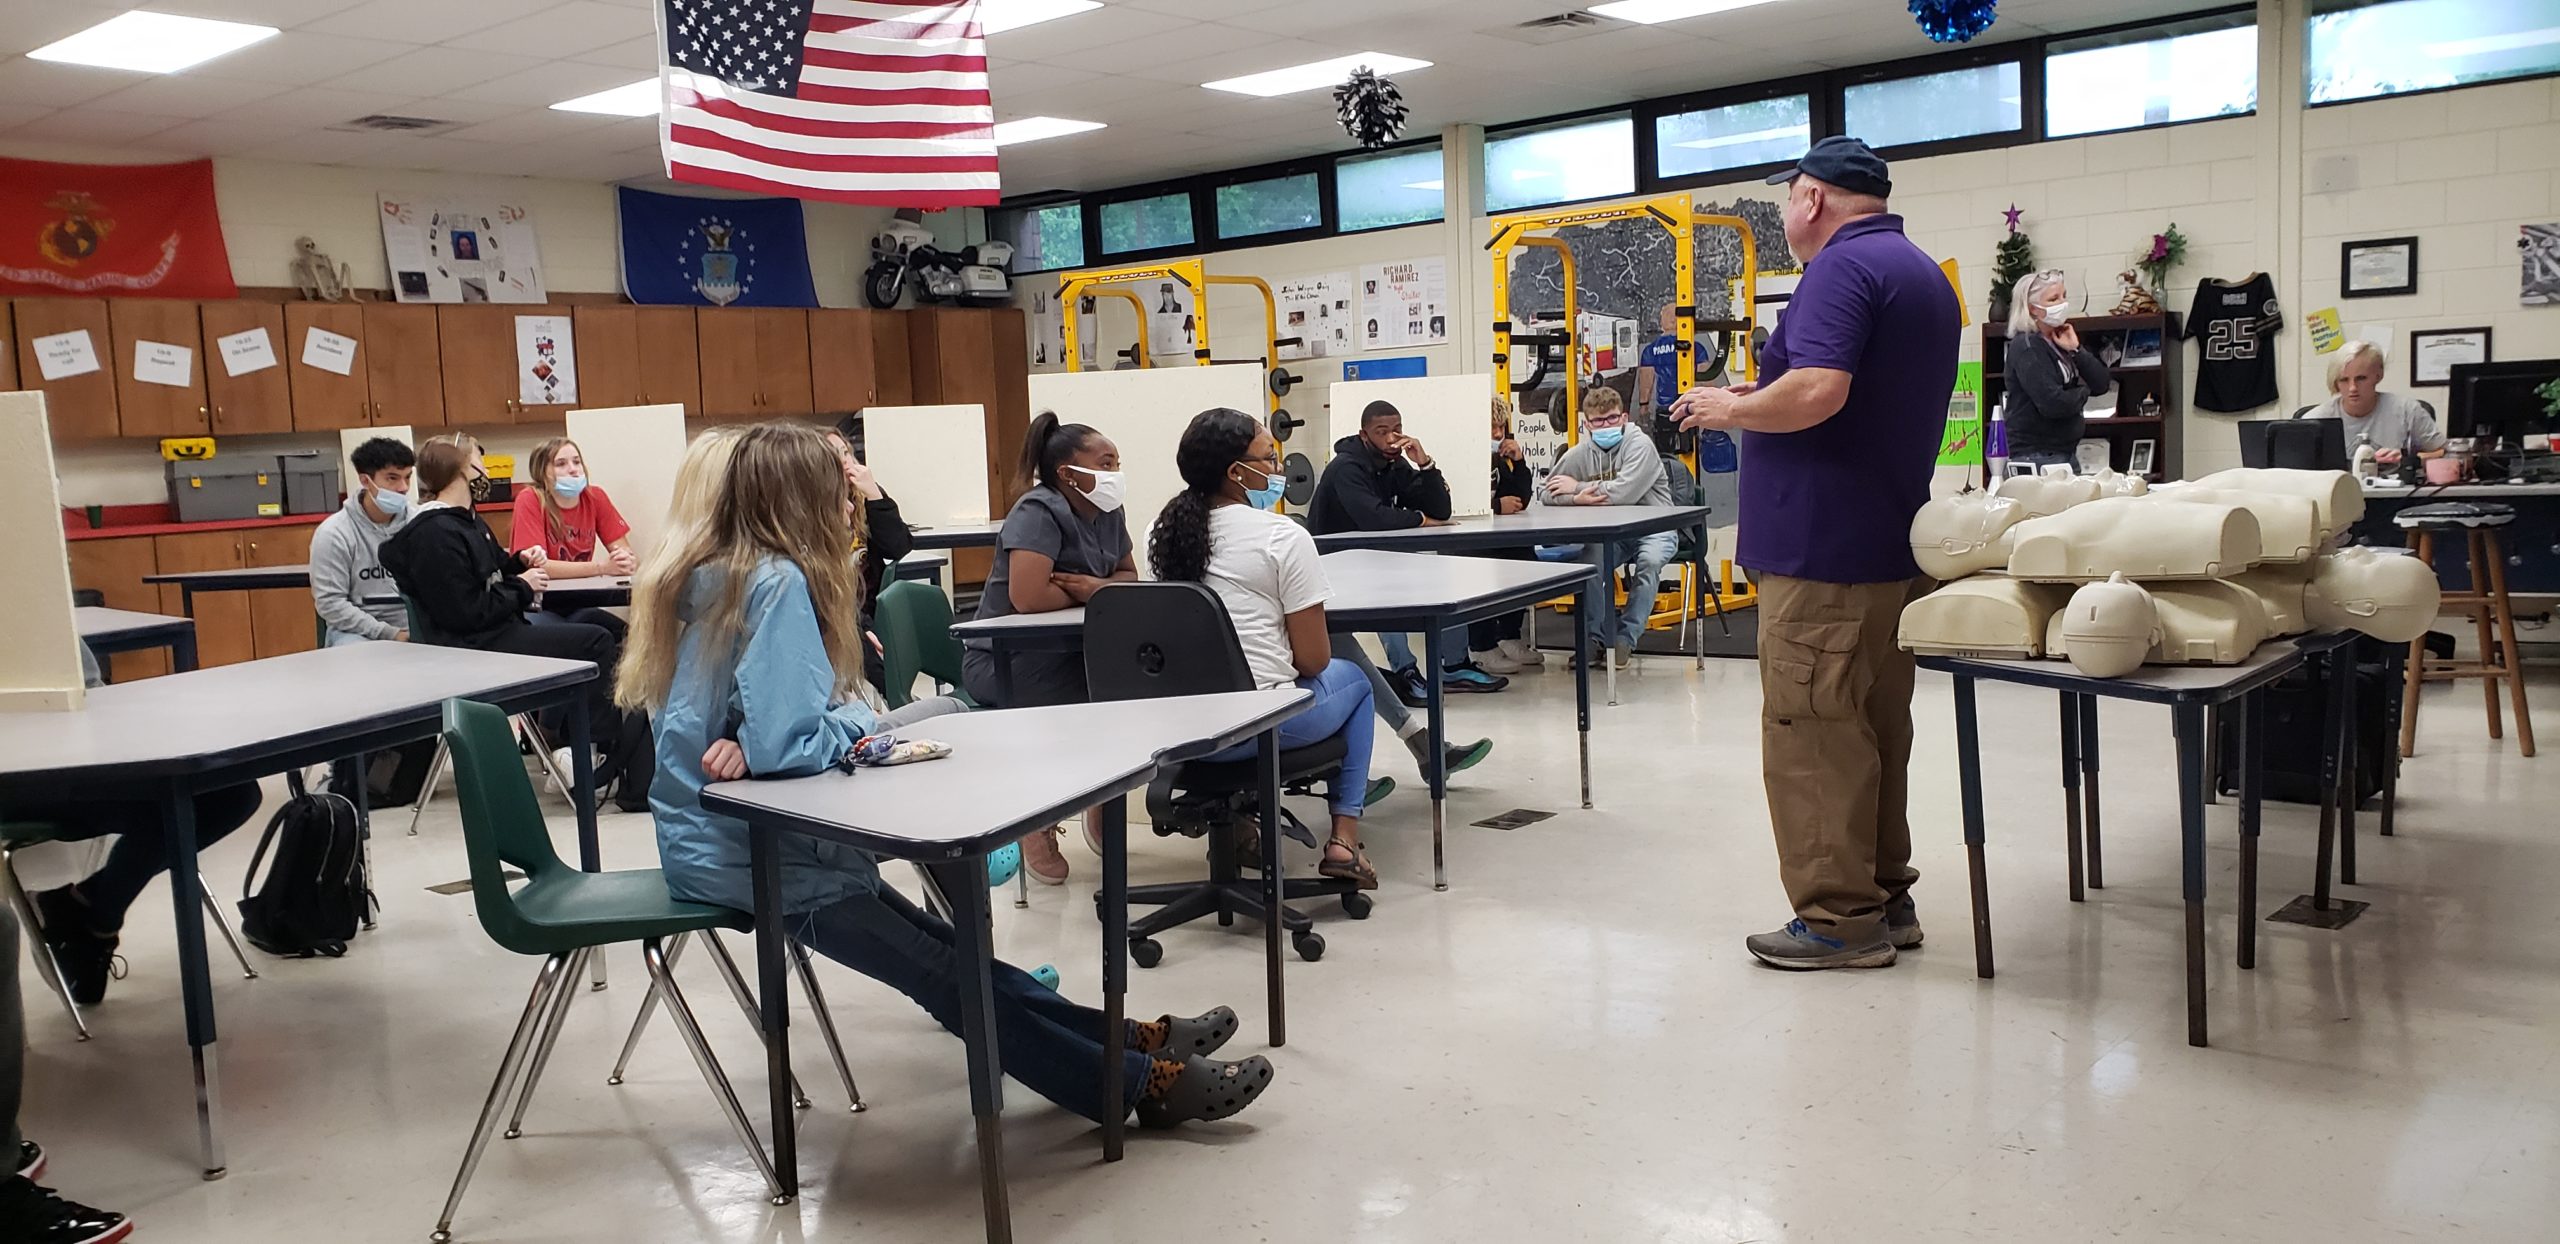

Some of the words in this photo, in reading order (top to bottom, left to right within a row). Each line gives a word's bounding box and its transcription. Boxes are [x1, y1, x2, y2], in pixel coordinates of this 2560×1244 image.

[1383, 264, 1413, 276] RICHARD
[1390, 272, 1419, 284] RAMIREZ
[2206, 317, 2259, 360] 25
[1517, 419, 1546, 437] People
